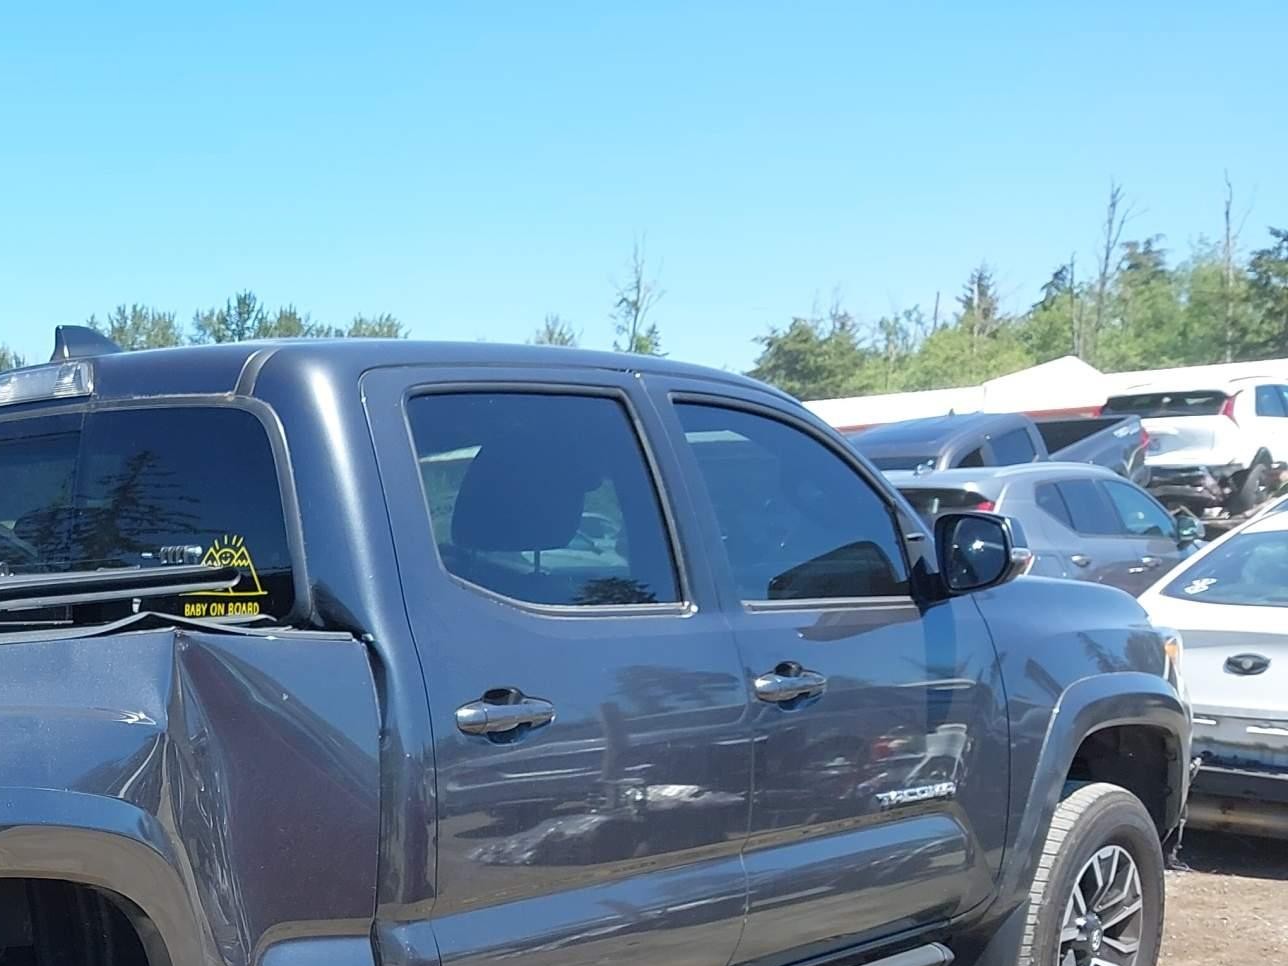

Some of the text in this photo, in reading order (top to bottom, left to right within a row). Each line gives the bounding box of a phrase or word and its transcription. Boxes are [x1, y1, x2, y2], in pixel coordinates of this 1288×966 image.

[184, 601, 260, 617] BABY ON BOARD
[875, 781, 956, 807] TACOMA
